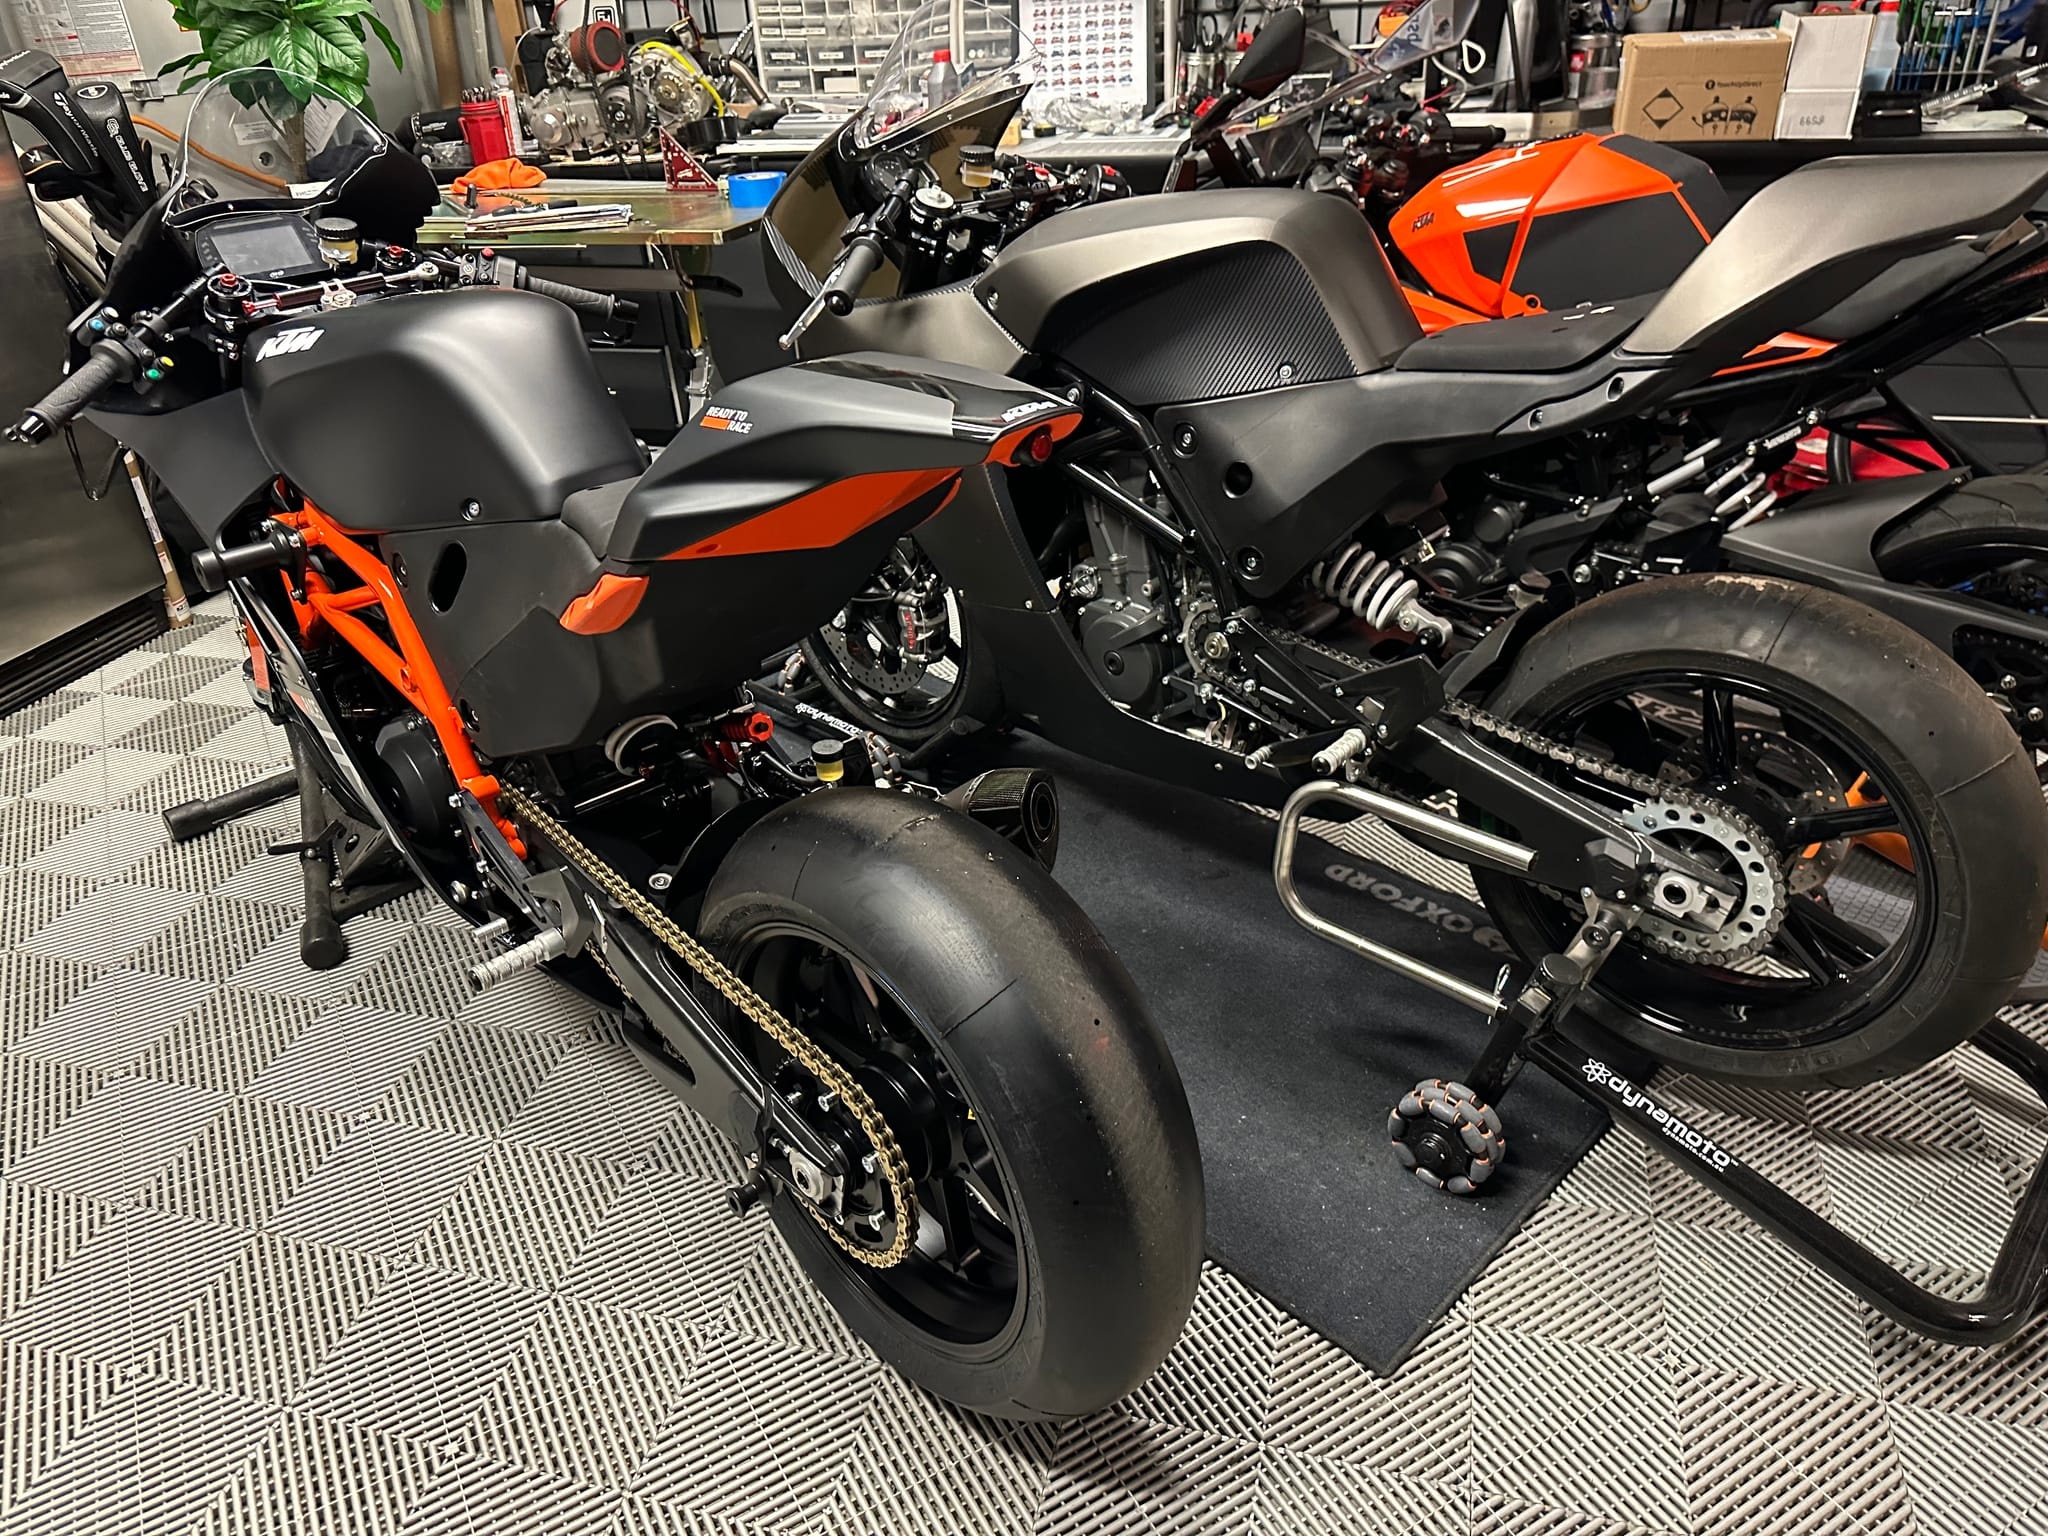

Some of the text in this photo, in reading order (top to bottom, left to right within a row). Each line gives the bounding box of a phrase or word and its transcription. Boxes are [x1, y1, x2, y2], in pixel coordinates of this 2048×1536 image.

[1412, 211, 1434, 232] KTM
[255, 326, 325, 363] KTM
[705, 406, 749, 422] READY TO
[726, 420, 753, 434] RACE
[1324, 863, 1475, 933] OXFORD
[1661, 1126, 1725, 1174] dynamoto.com.au
